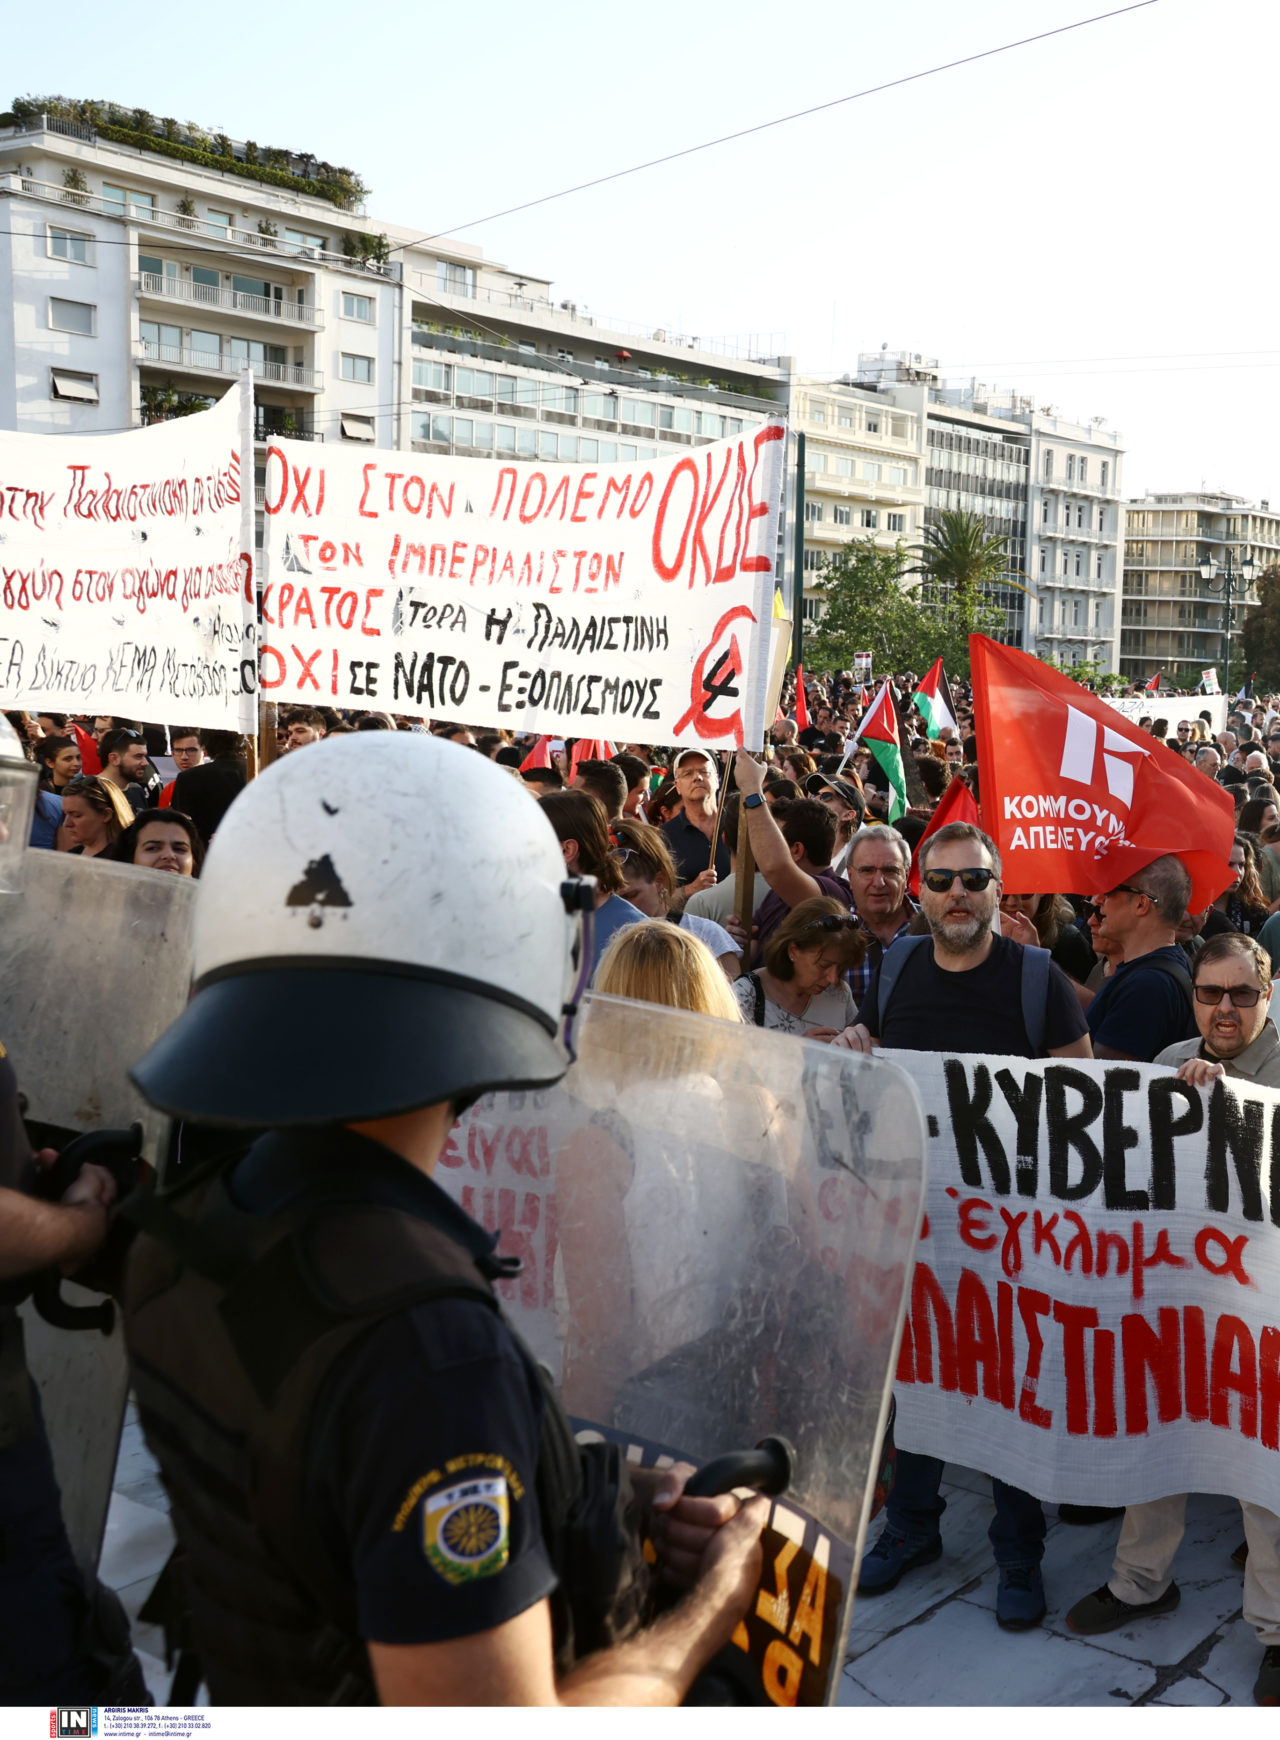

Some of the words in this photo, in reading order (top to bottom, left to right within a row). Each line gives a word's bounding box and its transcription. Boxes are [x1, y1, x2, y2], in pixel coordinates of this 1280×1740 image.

[264, 446, 325, 518] ΟΧΙ
[359, 463, 456, 520] ΣΤΟΝ
[490, 467, 654, 524] ΠΟΛΕΜΟ
[262, 582, 384, 637] ΚΡΑΤΟΣ
[527, 602, 669, 655] ΠΑΛΑΙΣΤΙΝΗ
[260, 645, 338, 697] ΟΧΙ
[349, 660, 381, 698] ΣΕ
[1003, 794, 1127, 846] ΚΟΜΜΟΥΝ
[946, 1186, 1258, 1301] έγκλημα
